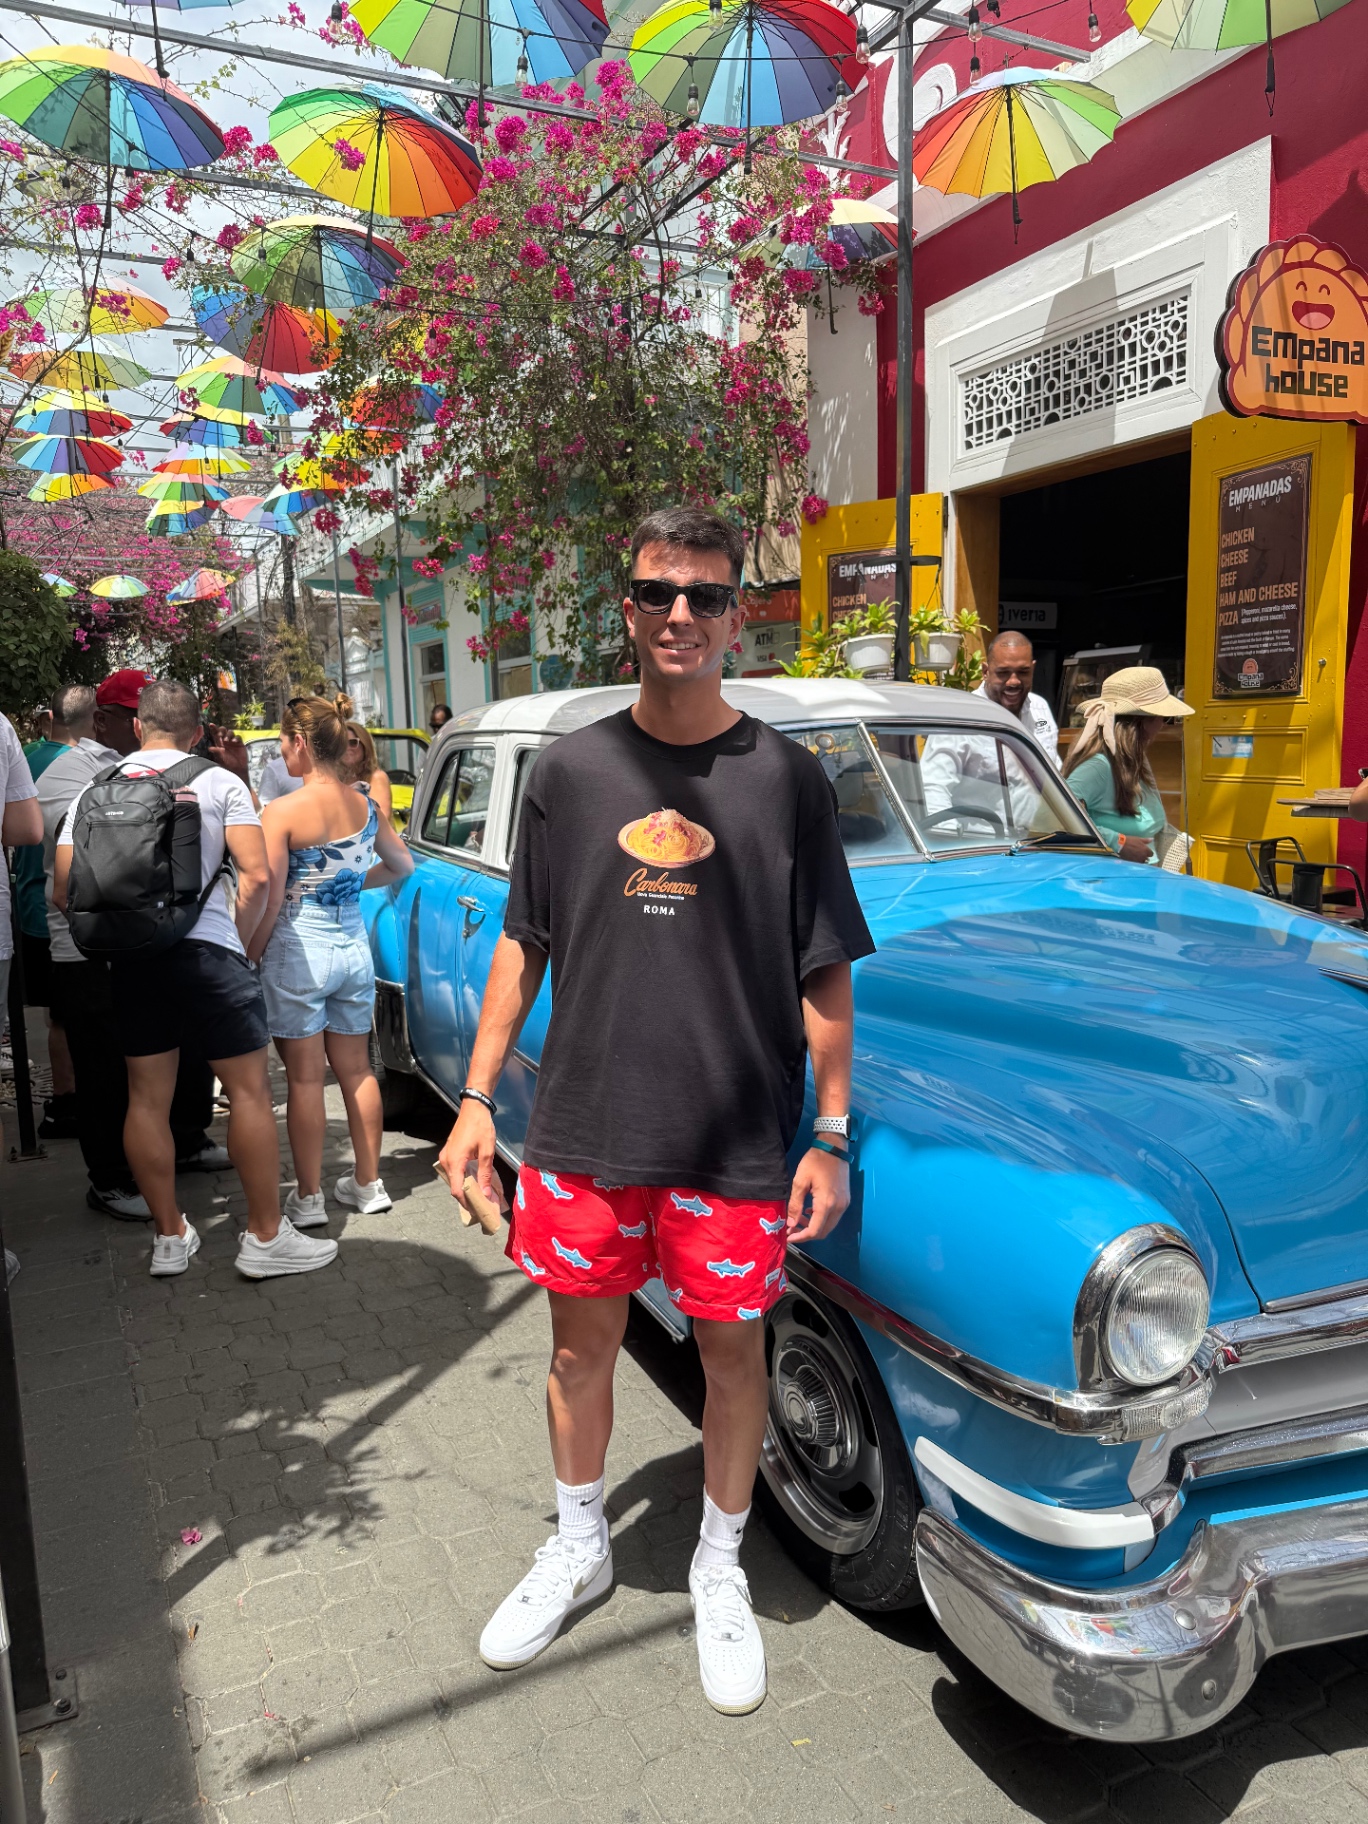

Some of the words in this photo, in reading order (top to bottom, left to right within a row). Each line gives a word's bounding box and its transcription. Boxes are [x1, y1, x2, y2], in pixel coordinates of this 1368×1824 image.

[1251, 325, 1365, 369] Empana
[1265, 362, 1348, 398] house
[1228, 475, 1292, 507] EMPANADAS
[1221, 526, 1255, 549] CHICKEN
[1220, 548, 1249, 568] CHEESE
[1220, 571, 1238, 588] BEEF
[832, 593, 867, 607] CHICKEN
[1219, 593, 1236, 608] HAM
[1237, 587, 1257, 605] AND
[1258, 581, 1298, 601] CHEESE
[1219, 610, 1239, 627] PIZZA
[755, 633, 774, 647] ATM
[623, 867, 698, 897] Carbonara
[643, 904, 675, 916] ROMA
